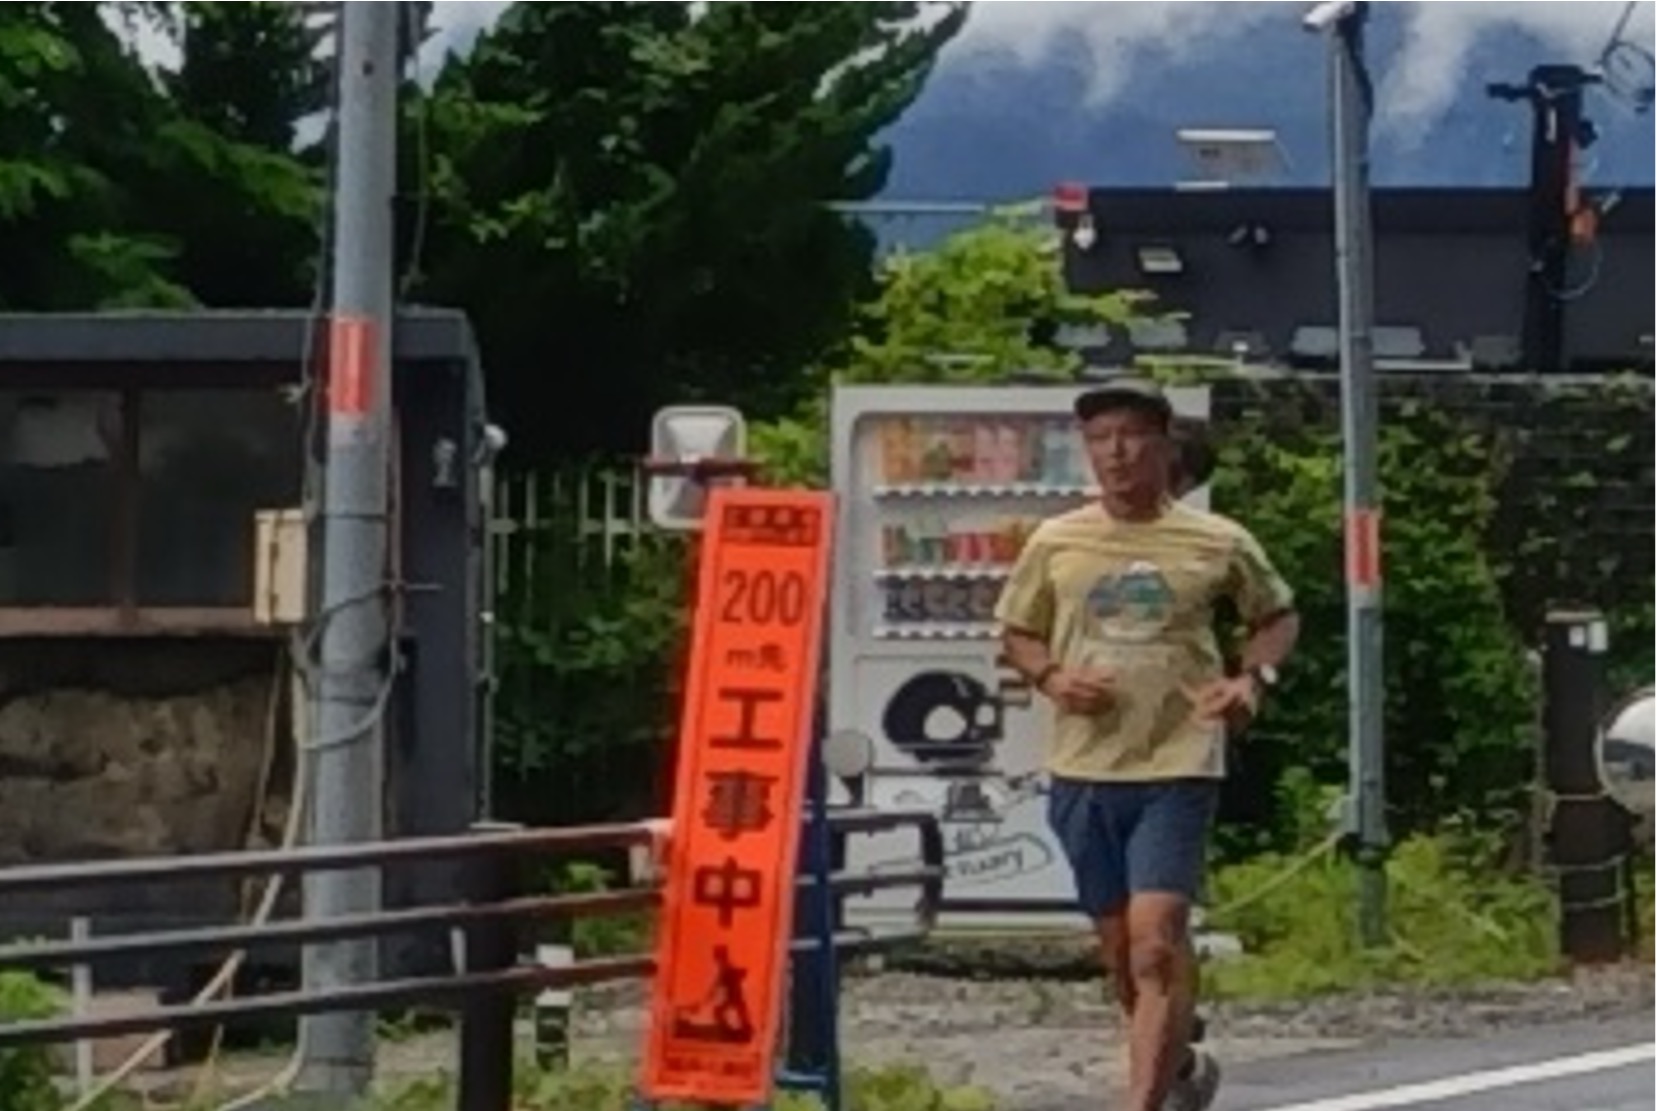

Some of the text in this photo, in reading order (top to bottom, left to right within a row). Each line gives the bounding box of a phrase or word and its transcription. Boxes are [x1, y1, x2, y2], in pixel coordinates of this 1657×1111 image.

[721, 567, 805, 627] 200
[694, 686, 784, 928] 工事中
